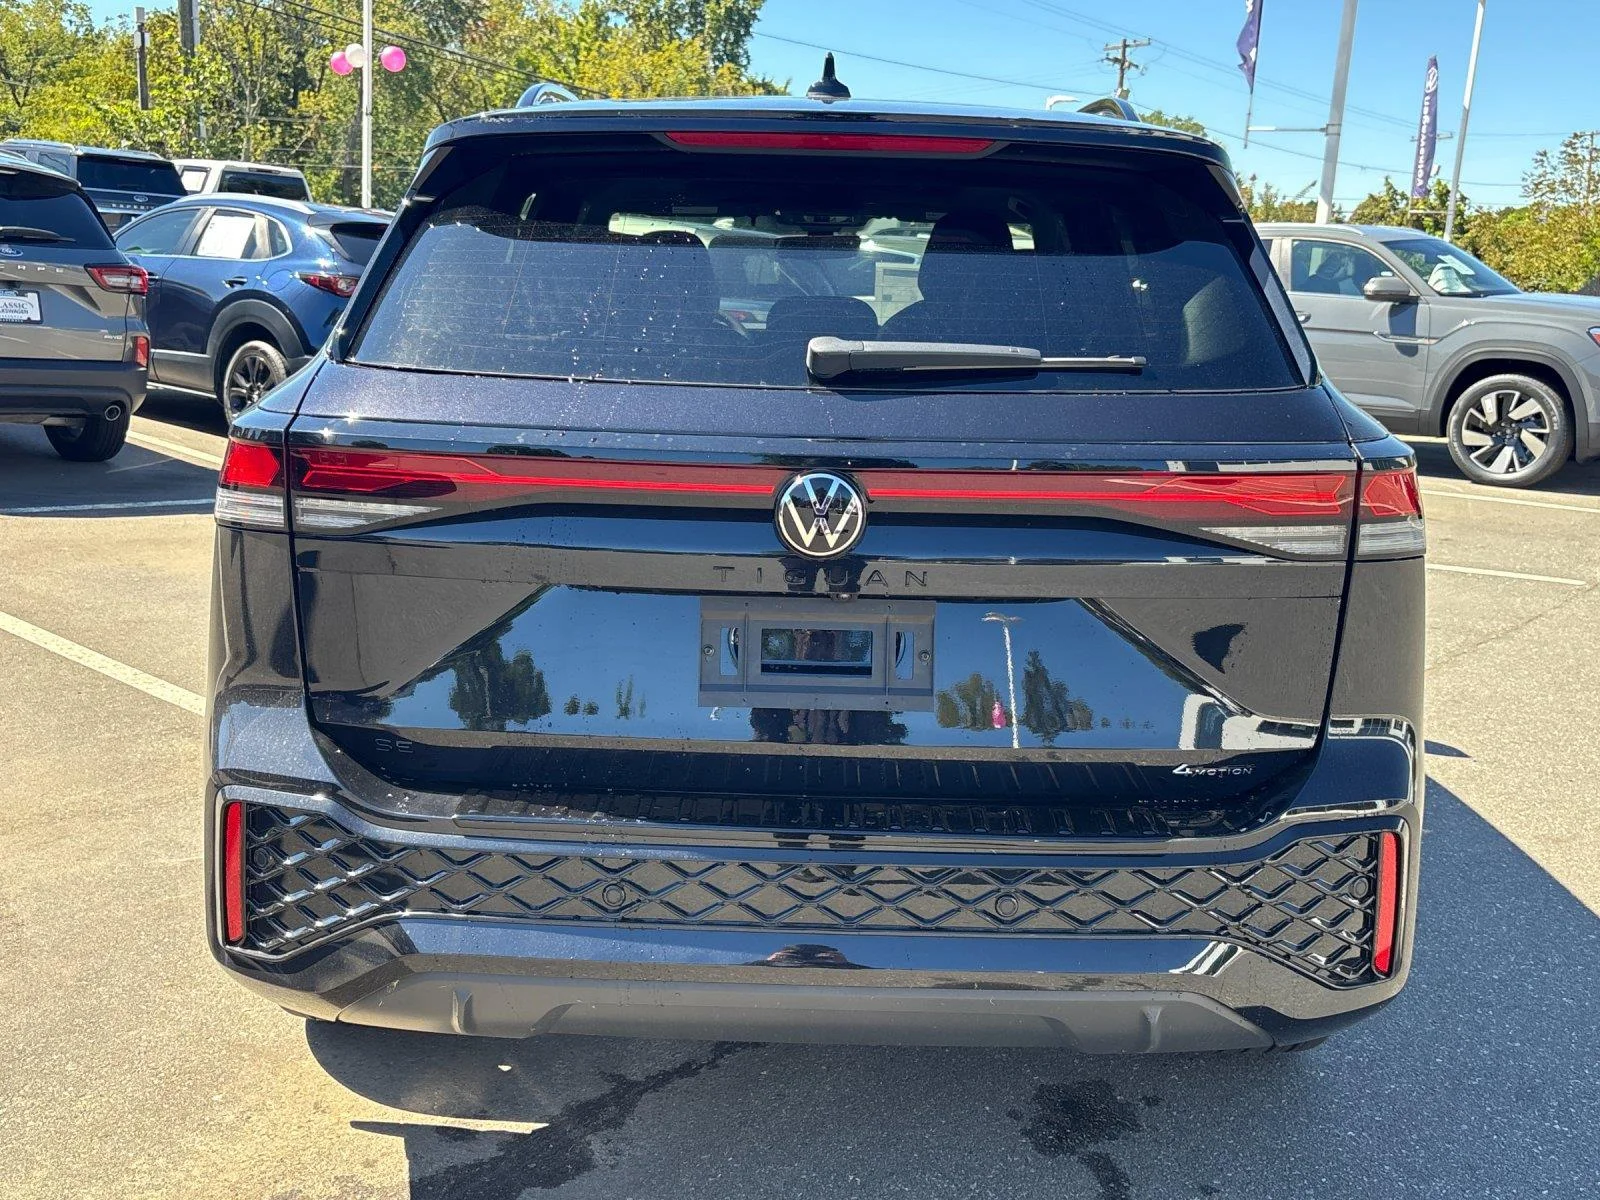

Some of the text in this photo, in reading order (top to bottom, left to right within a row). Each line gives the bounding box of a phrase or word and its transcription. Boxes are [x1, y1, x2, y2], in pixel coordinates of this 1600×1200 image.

[712, 565, 928, 588] TIGUAN
[374, 738, 414, 753] SE
[1172, 763, 1253, 776] 4MOTION
